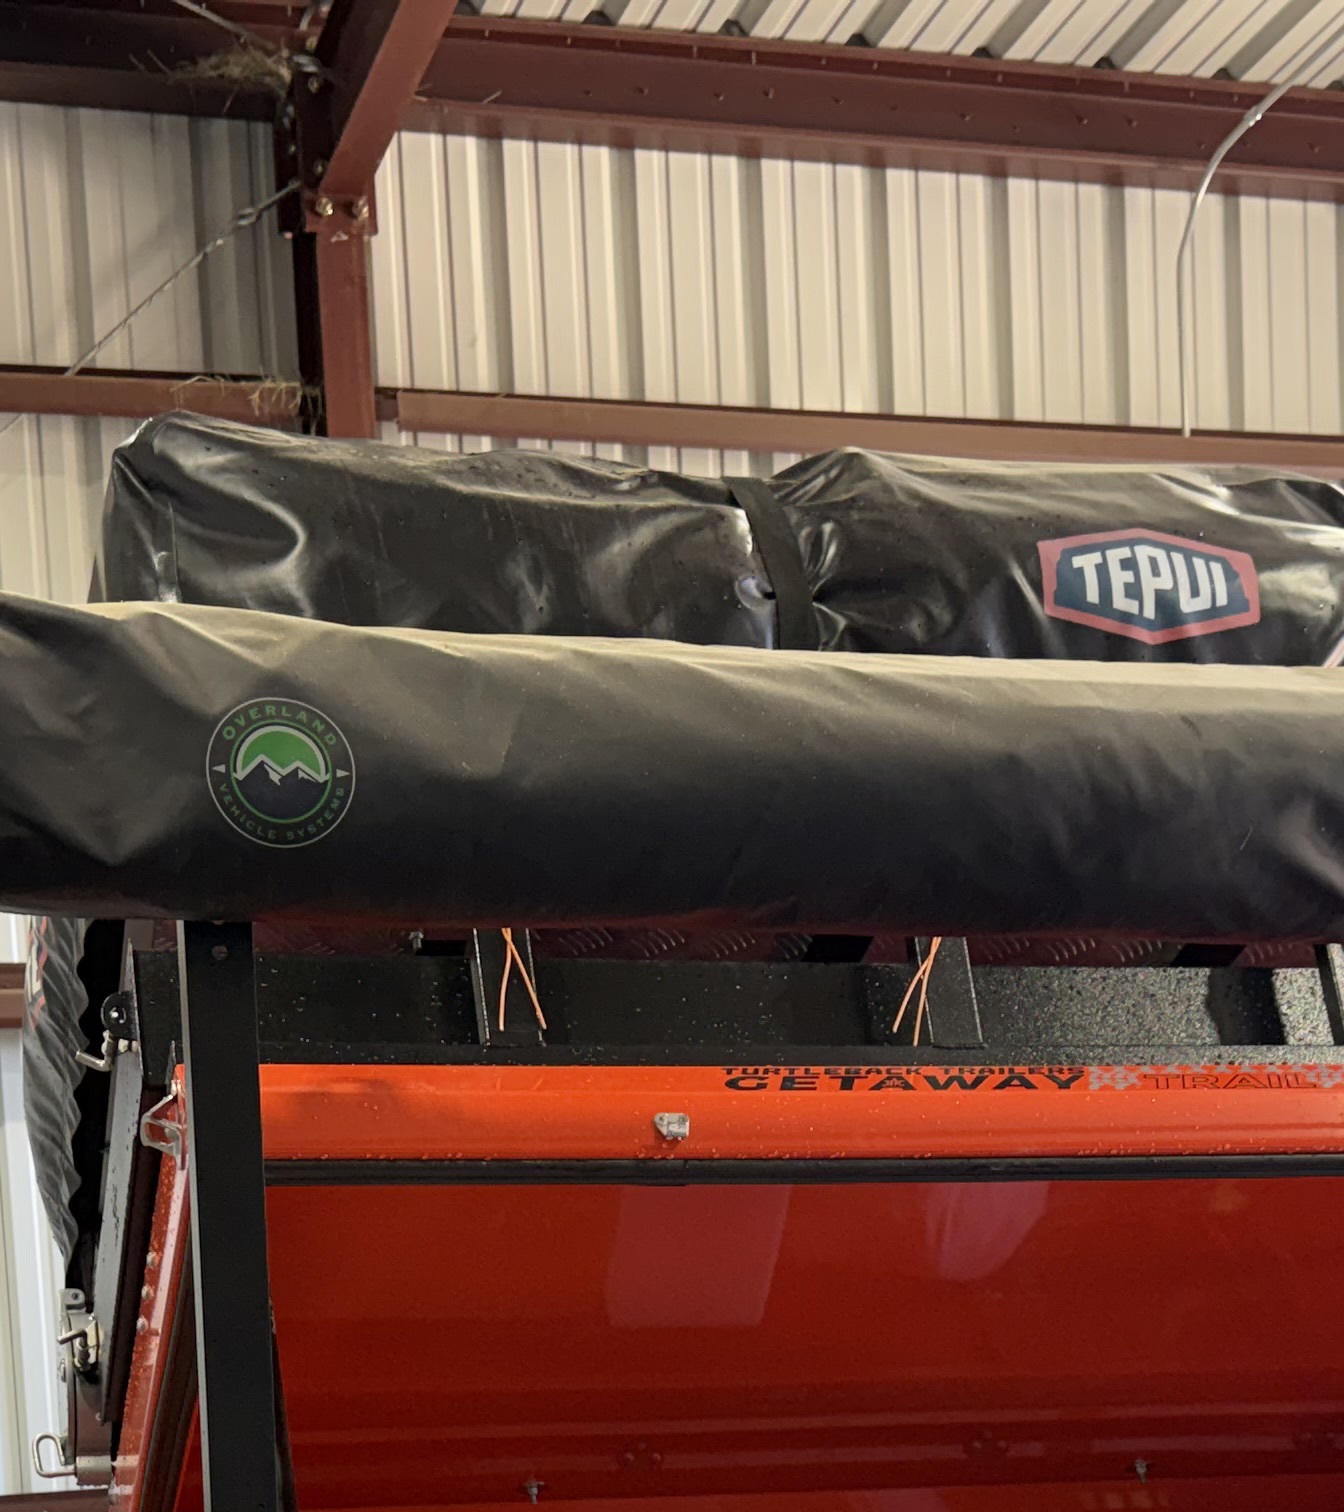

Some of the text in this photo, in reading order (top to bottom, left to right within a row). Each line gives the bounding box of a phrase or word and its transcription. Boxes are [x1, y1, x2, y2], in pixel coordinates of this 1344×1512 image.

[1071, 545, 1228, 620] TEPUI
[222, 705, 336, 745] OVERLAND
[219, 783, 345, 841] VEHICLE SYSTEMS
[721, 1066, 1085, 1075] TURTLEBACK TRAILERS
[724, 1073, 1317, 1091] GETAWAY TRAIL
